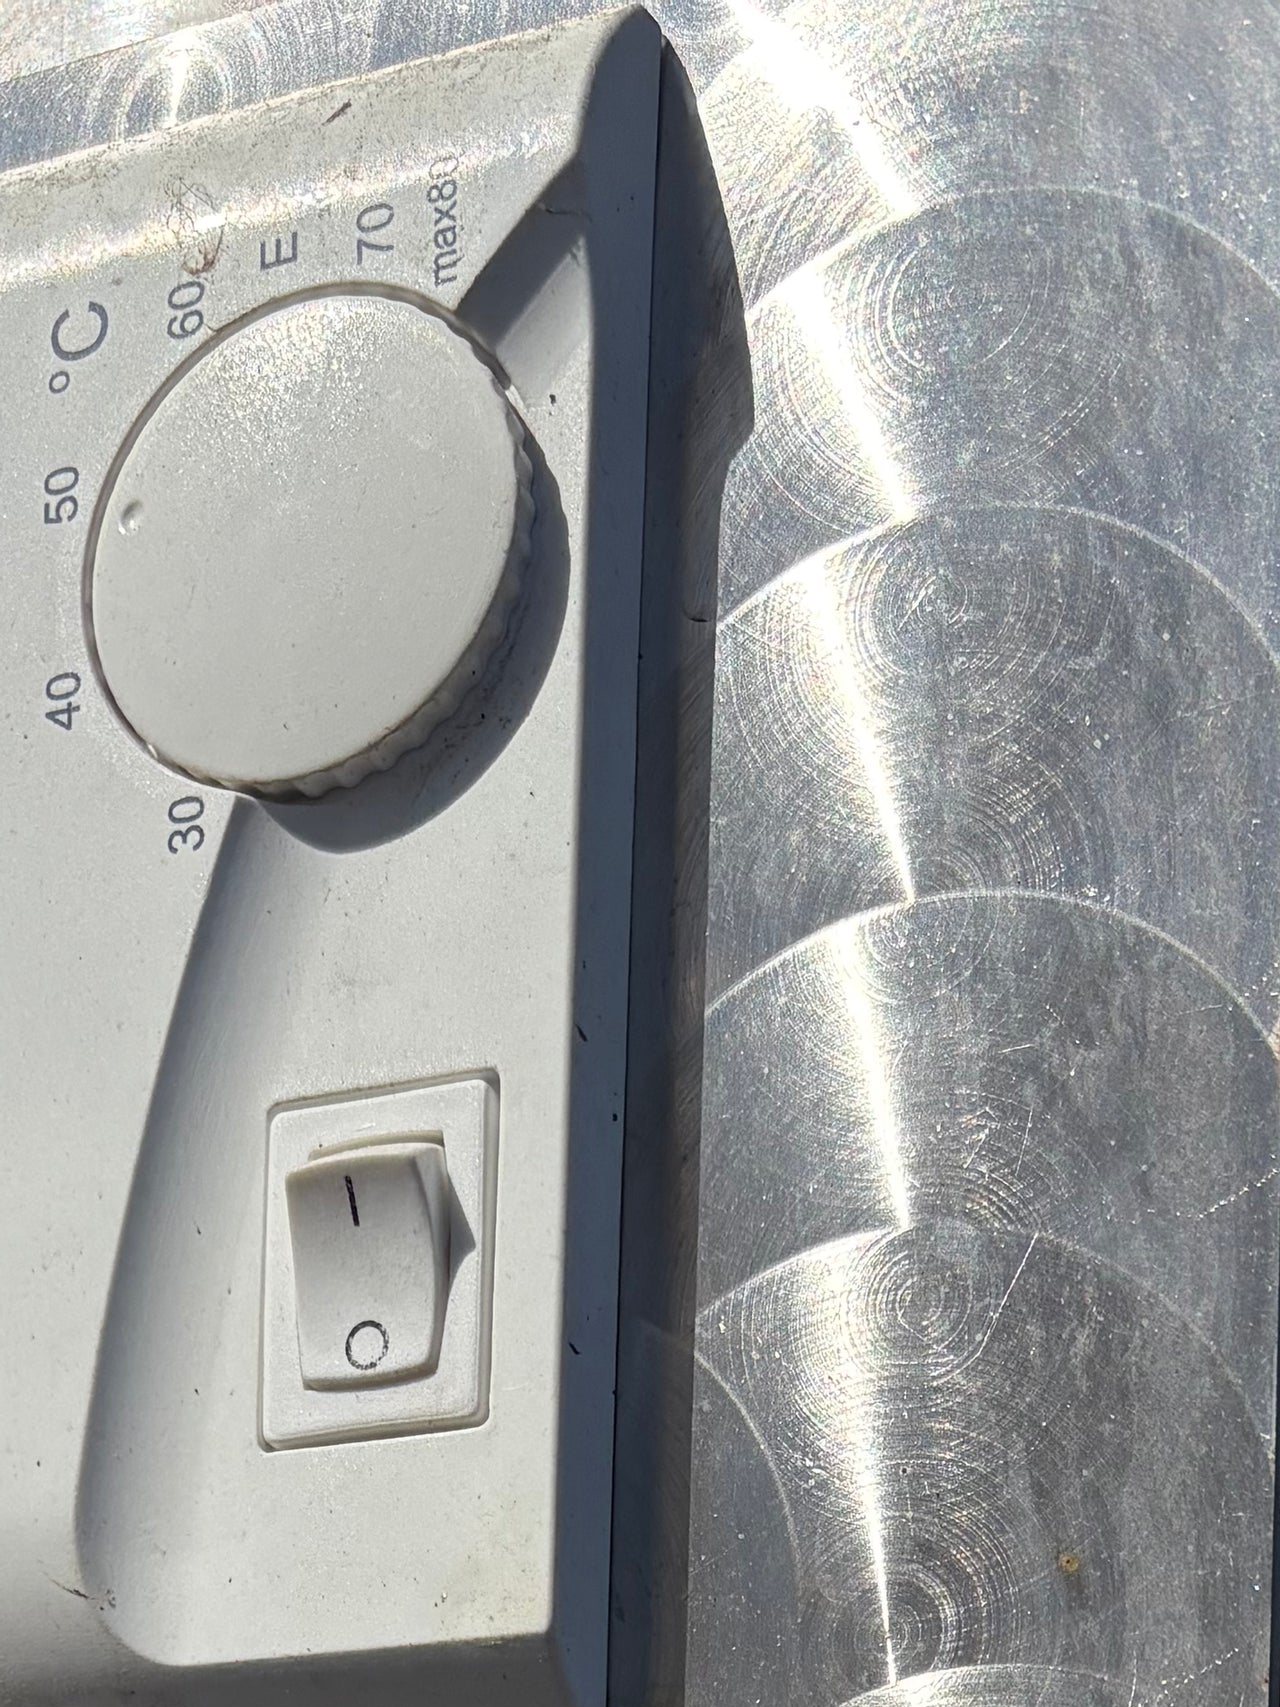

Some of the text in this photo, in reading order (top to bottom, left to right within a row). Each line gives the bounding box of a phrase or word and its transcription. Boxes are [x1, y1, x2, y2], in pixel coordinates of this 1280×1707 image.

[261, 231, 297, 270] E
[356, 203, 396, 264] 70
[166, 279, 206, 341] 60
[49, 301, 109, 394] °C
[44, 467, 80, 525] 50
[45, 671, 82, 731] 40
[167, 795, 205, 854] 30
